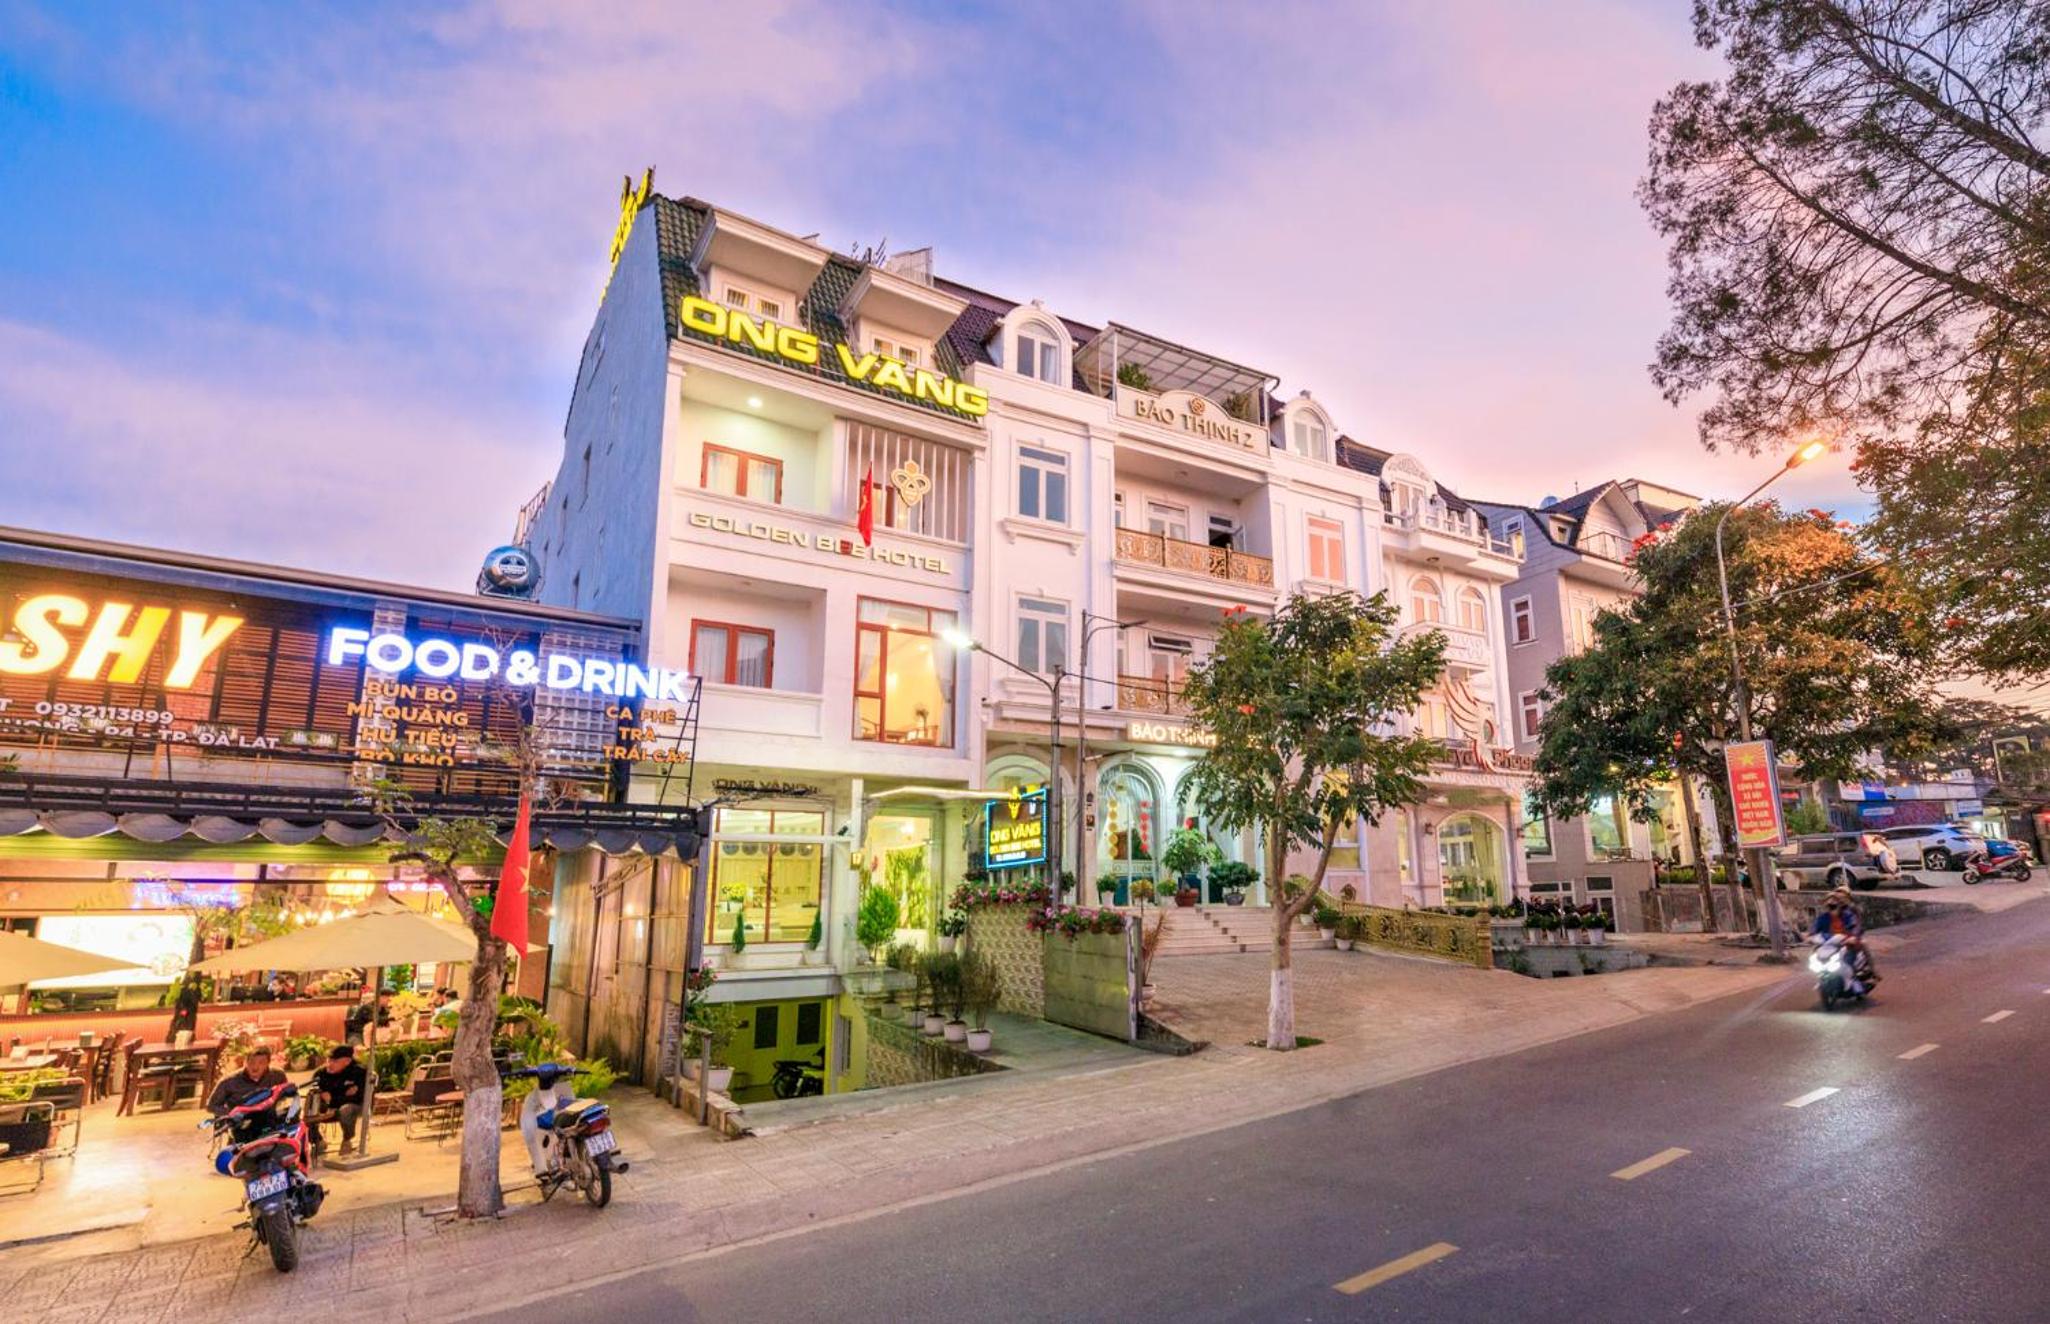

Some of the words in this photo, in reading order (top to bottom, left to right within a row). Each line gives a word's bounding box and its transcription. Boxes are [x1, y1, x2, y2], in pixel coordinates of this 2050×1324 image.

[680, 295, 818, 364] ONG
[835, 343, 988, 417] VÀNG
[1243, 432, 1253, 448] 2
[688, 512, 809, 548] GOLDEN
[872, 547, 952, 575] HOTEL
[0, 594, 245, 689] SHY
[328, 627, 499, 679] FOOD
[545, 654, 691, 703] DRINK
[424, 685, 458, 702] BÒ
[35, 701, 174, 725] 0932113899
[382, 703, 469, 726] QUẢNG
[990, 828, 1010, 844] ONG
